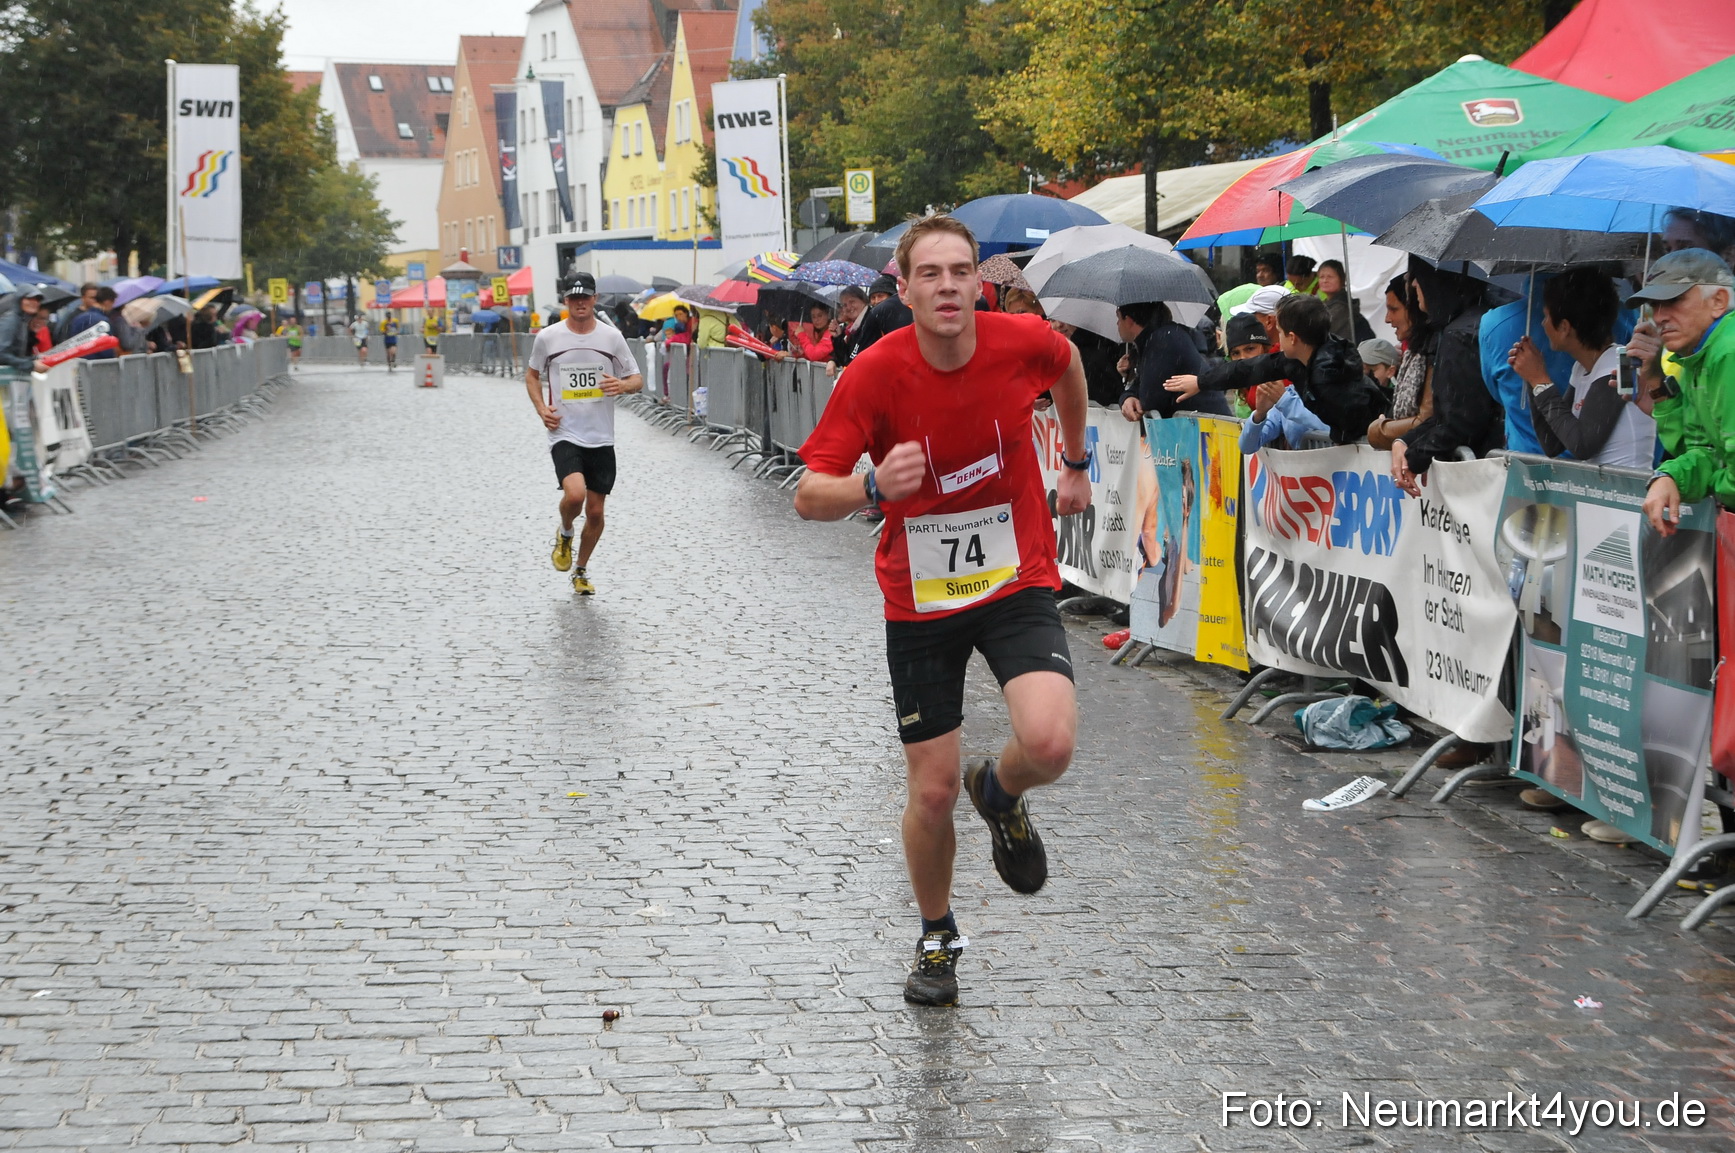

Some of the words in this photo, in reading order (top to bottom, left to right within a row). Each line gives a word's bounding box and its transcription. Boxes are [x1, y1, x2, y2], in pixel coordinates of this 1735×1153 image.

[179, 99, 234, 118] swn
[273, 286, 283, 299] D
[496, 284, 505, 297] D
[569, 372, 596, 388] 305
[956, 466, 982, 485] DEHN
[909, 524, 942, 534] PARTL
[945, 516, 994, 533] Neumarkt
[940, 534, 986, 573] 74
[1423, 554, 1434, 584] Im
[1437, 558, 1472, 597] Herzen
[946, 579, 990, 596] Simon
[1441, 597, 1465, 634] Stadt
